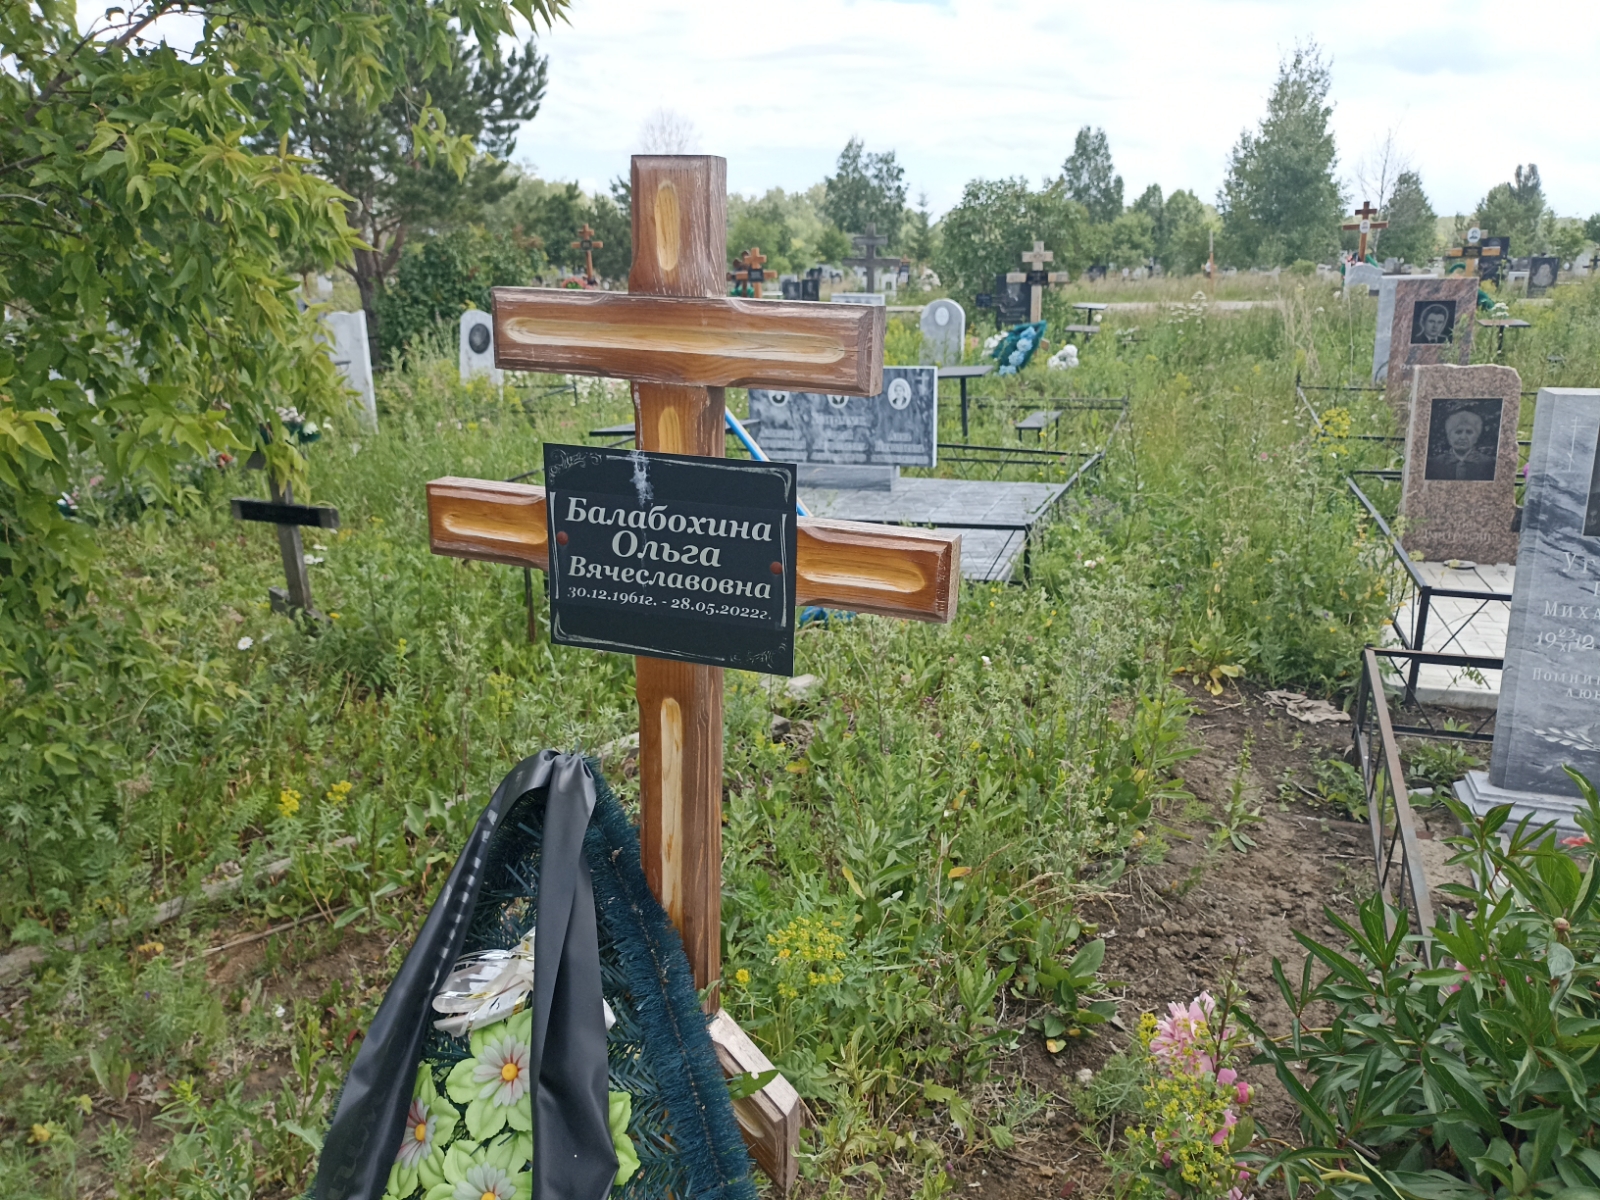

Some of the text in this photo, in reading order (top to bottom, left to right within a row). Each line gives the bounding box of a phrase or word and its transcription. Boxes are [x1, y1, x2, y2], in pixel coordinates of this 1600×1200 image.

[565, 496, 773, 542] Балабохина
[611, 530, 722, 568] Ольга
[567, 555, 772, 599] Вячеславовна
[567, 586, 658, 606] 30.12.1961г.
[670, 597, 772, 620] 28.05.2022г.
